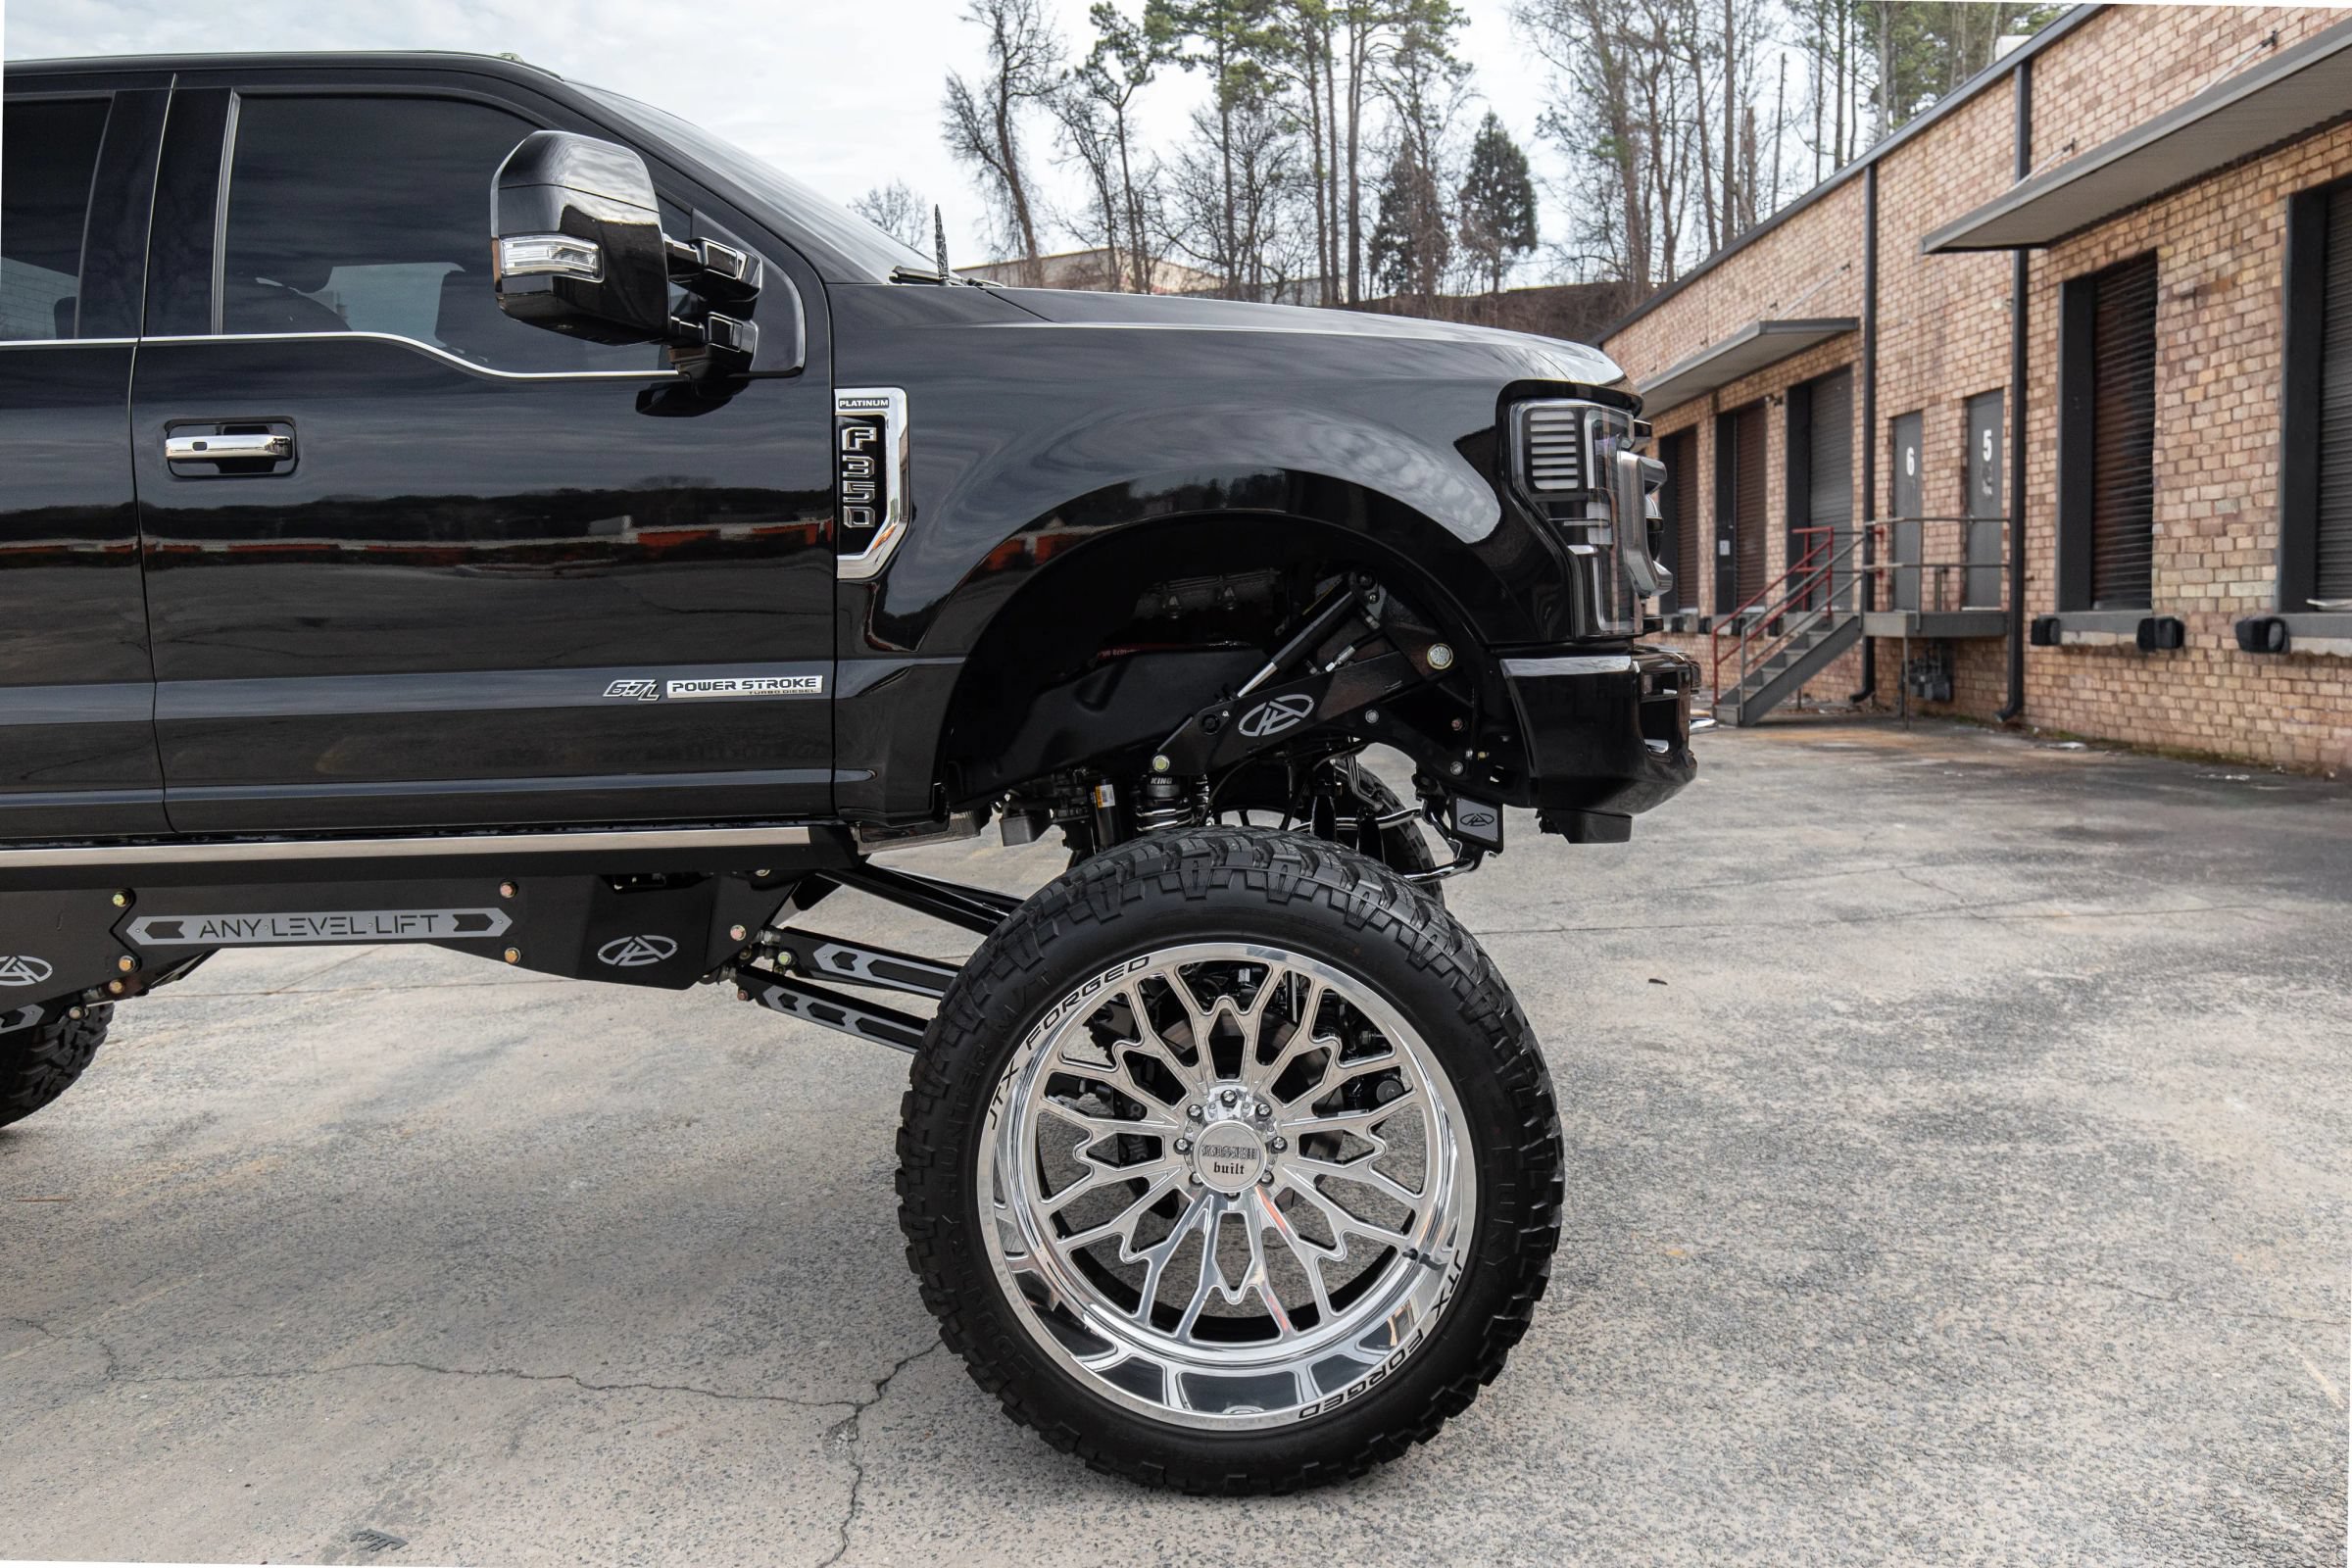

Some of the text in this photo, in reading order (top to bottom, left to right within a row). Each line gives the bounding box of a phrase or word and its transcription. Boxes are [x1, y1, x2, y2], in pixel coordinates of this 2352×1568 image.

[1983, 429, 1992, 462] 5
[1906, 447, 1915, 476] 6
[672, 677, 816, 693] POWER STROKE
[199, 913, 439, 939] ANY LEVEL LIFT
[990, 956, 1150, 1130] JTX FORGED
[1213, 1161, 1245, 1175] built
[1298, 1250, 1462, 1419] JTX FORGED
